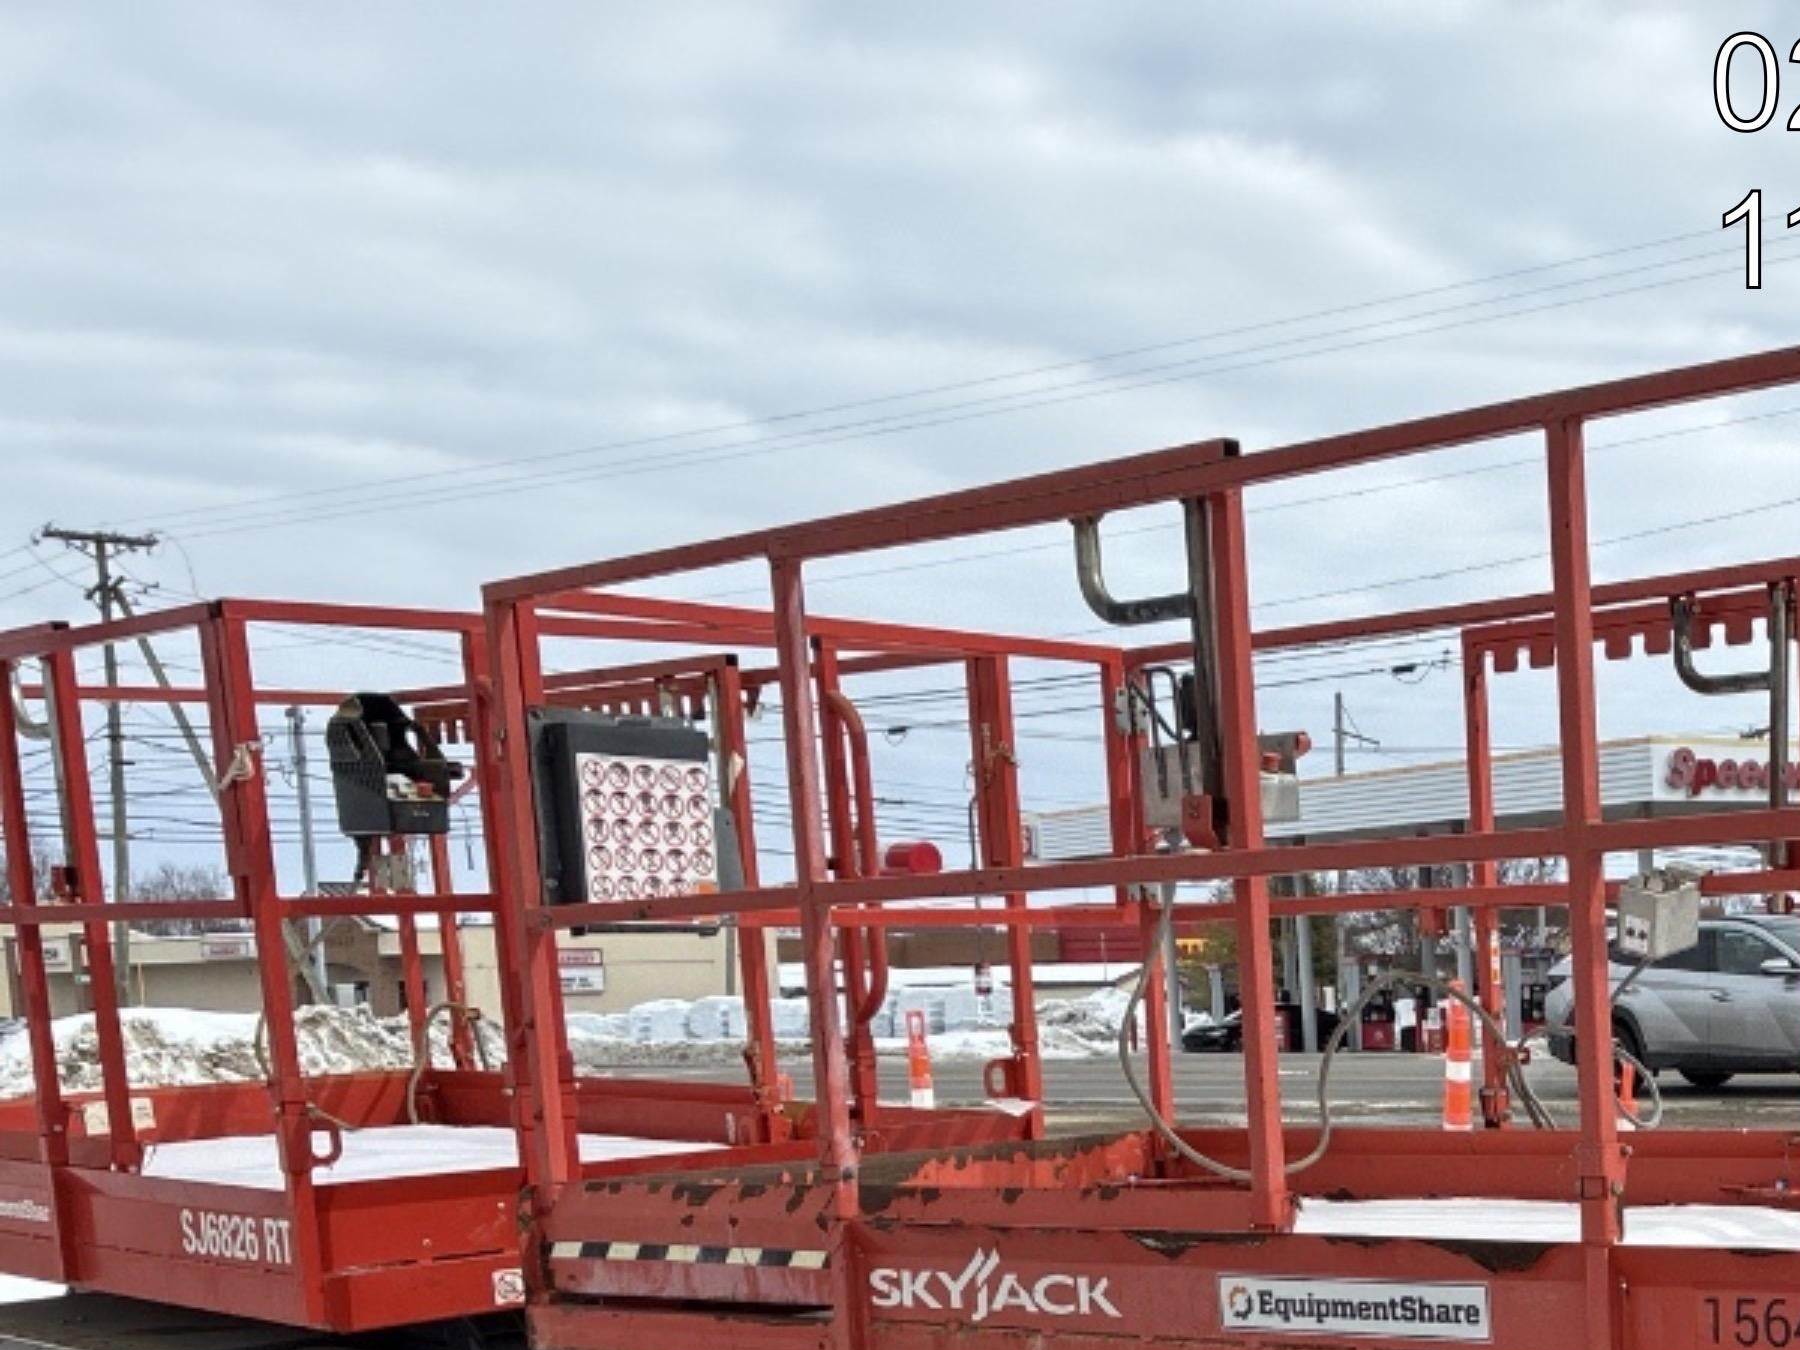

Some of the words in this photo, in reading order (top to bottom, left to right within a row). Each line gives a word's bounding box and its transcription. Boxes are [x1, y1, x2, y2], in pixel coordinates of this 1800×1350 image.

[180, 1208, 259, 1262] SJ6826
[263, 1216, 293, 1265] RT
[869, 1247, 1123, 1321] SKYJACK
[1257, 1290, 1481, 1325] EquipmentShare
